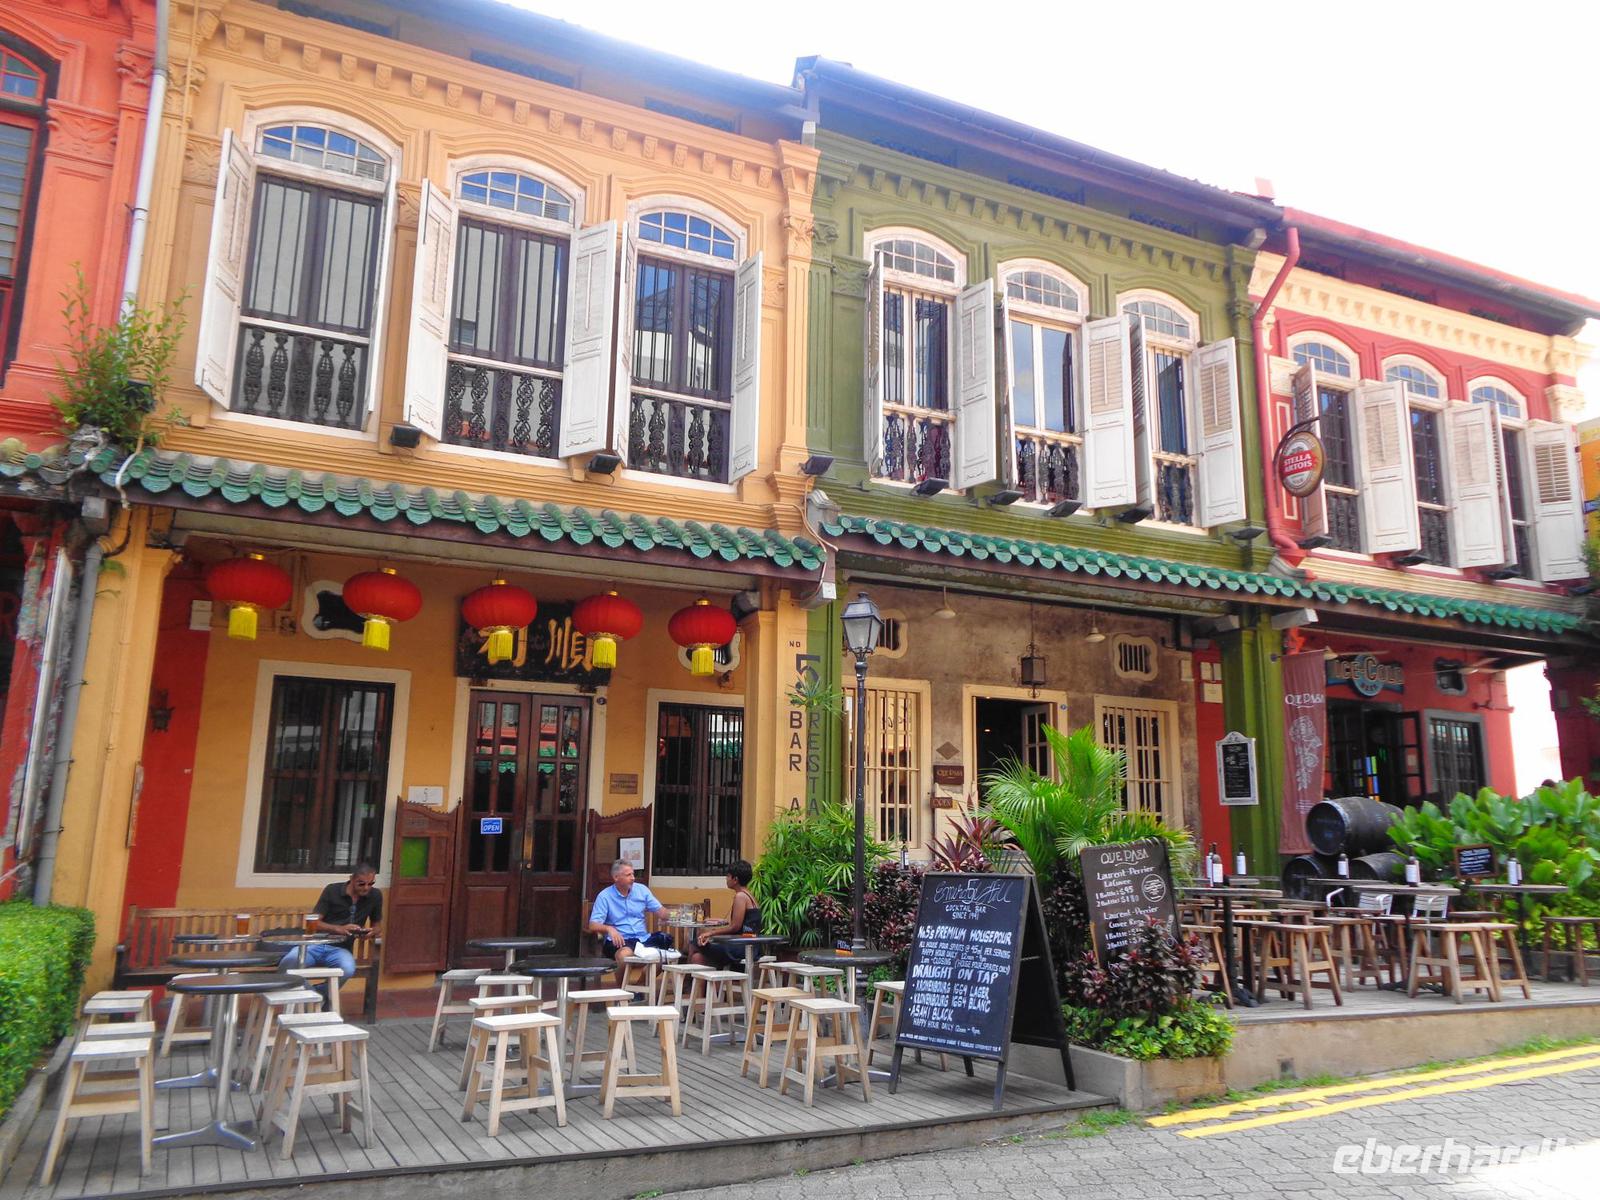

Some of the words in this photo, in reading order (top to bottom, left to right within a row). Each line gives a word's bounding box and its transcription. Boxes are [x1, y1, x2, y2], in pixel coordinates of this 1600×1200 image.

[795, 653, 821, 698] 5
[789, 711, 803, 772] BAR
[1100, 851, 1122, 864] QUE
[1124, 848, 1150, 862] PASA
[946, 904, 971, 912] COCKTAIL
[975, 905, 987, 913] BAR
[952, 912, 967, 920] SINCE
[934, 926, 967, 940] PREMIUM
[912, 964, 954, 980] DRAUGHT
[958, 968, 973, 981] ON
[977, 970, 999, 985] TAP
[970, 985, 990, 1000] LAGER
[910, 1004, 930, 1018] ASAHI
[932, 1007, 954, 1022] BLACK
[968, 997, 992, 1014] BLANC
